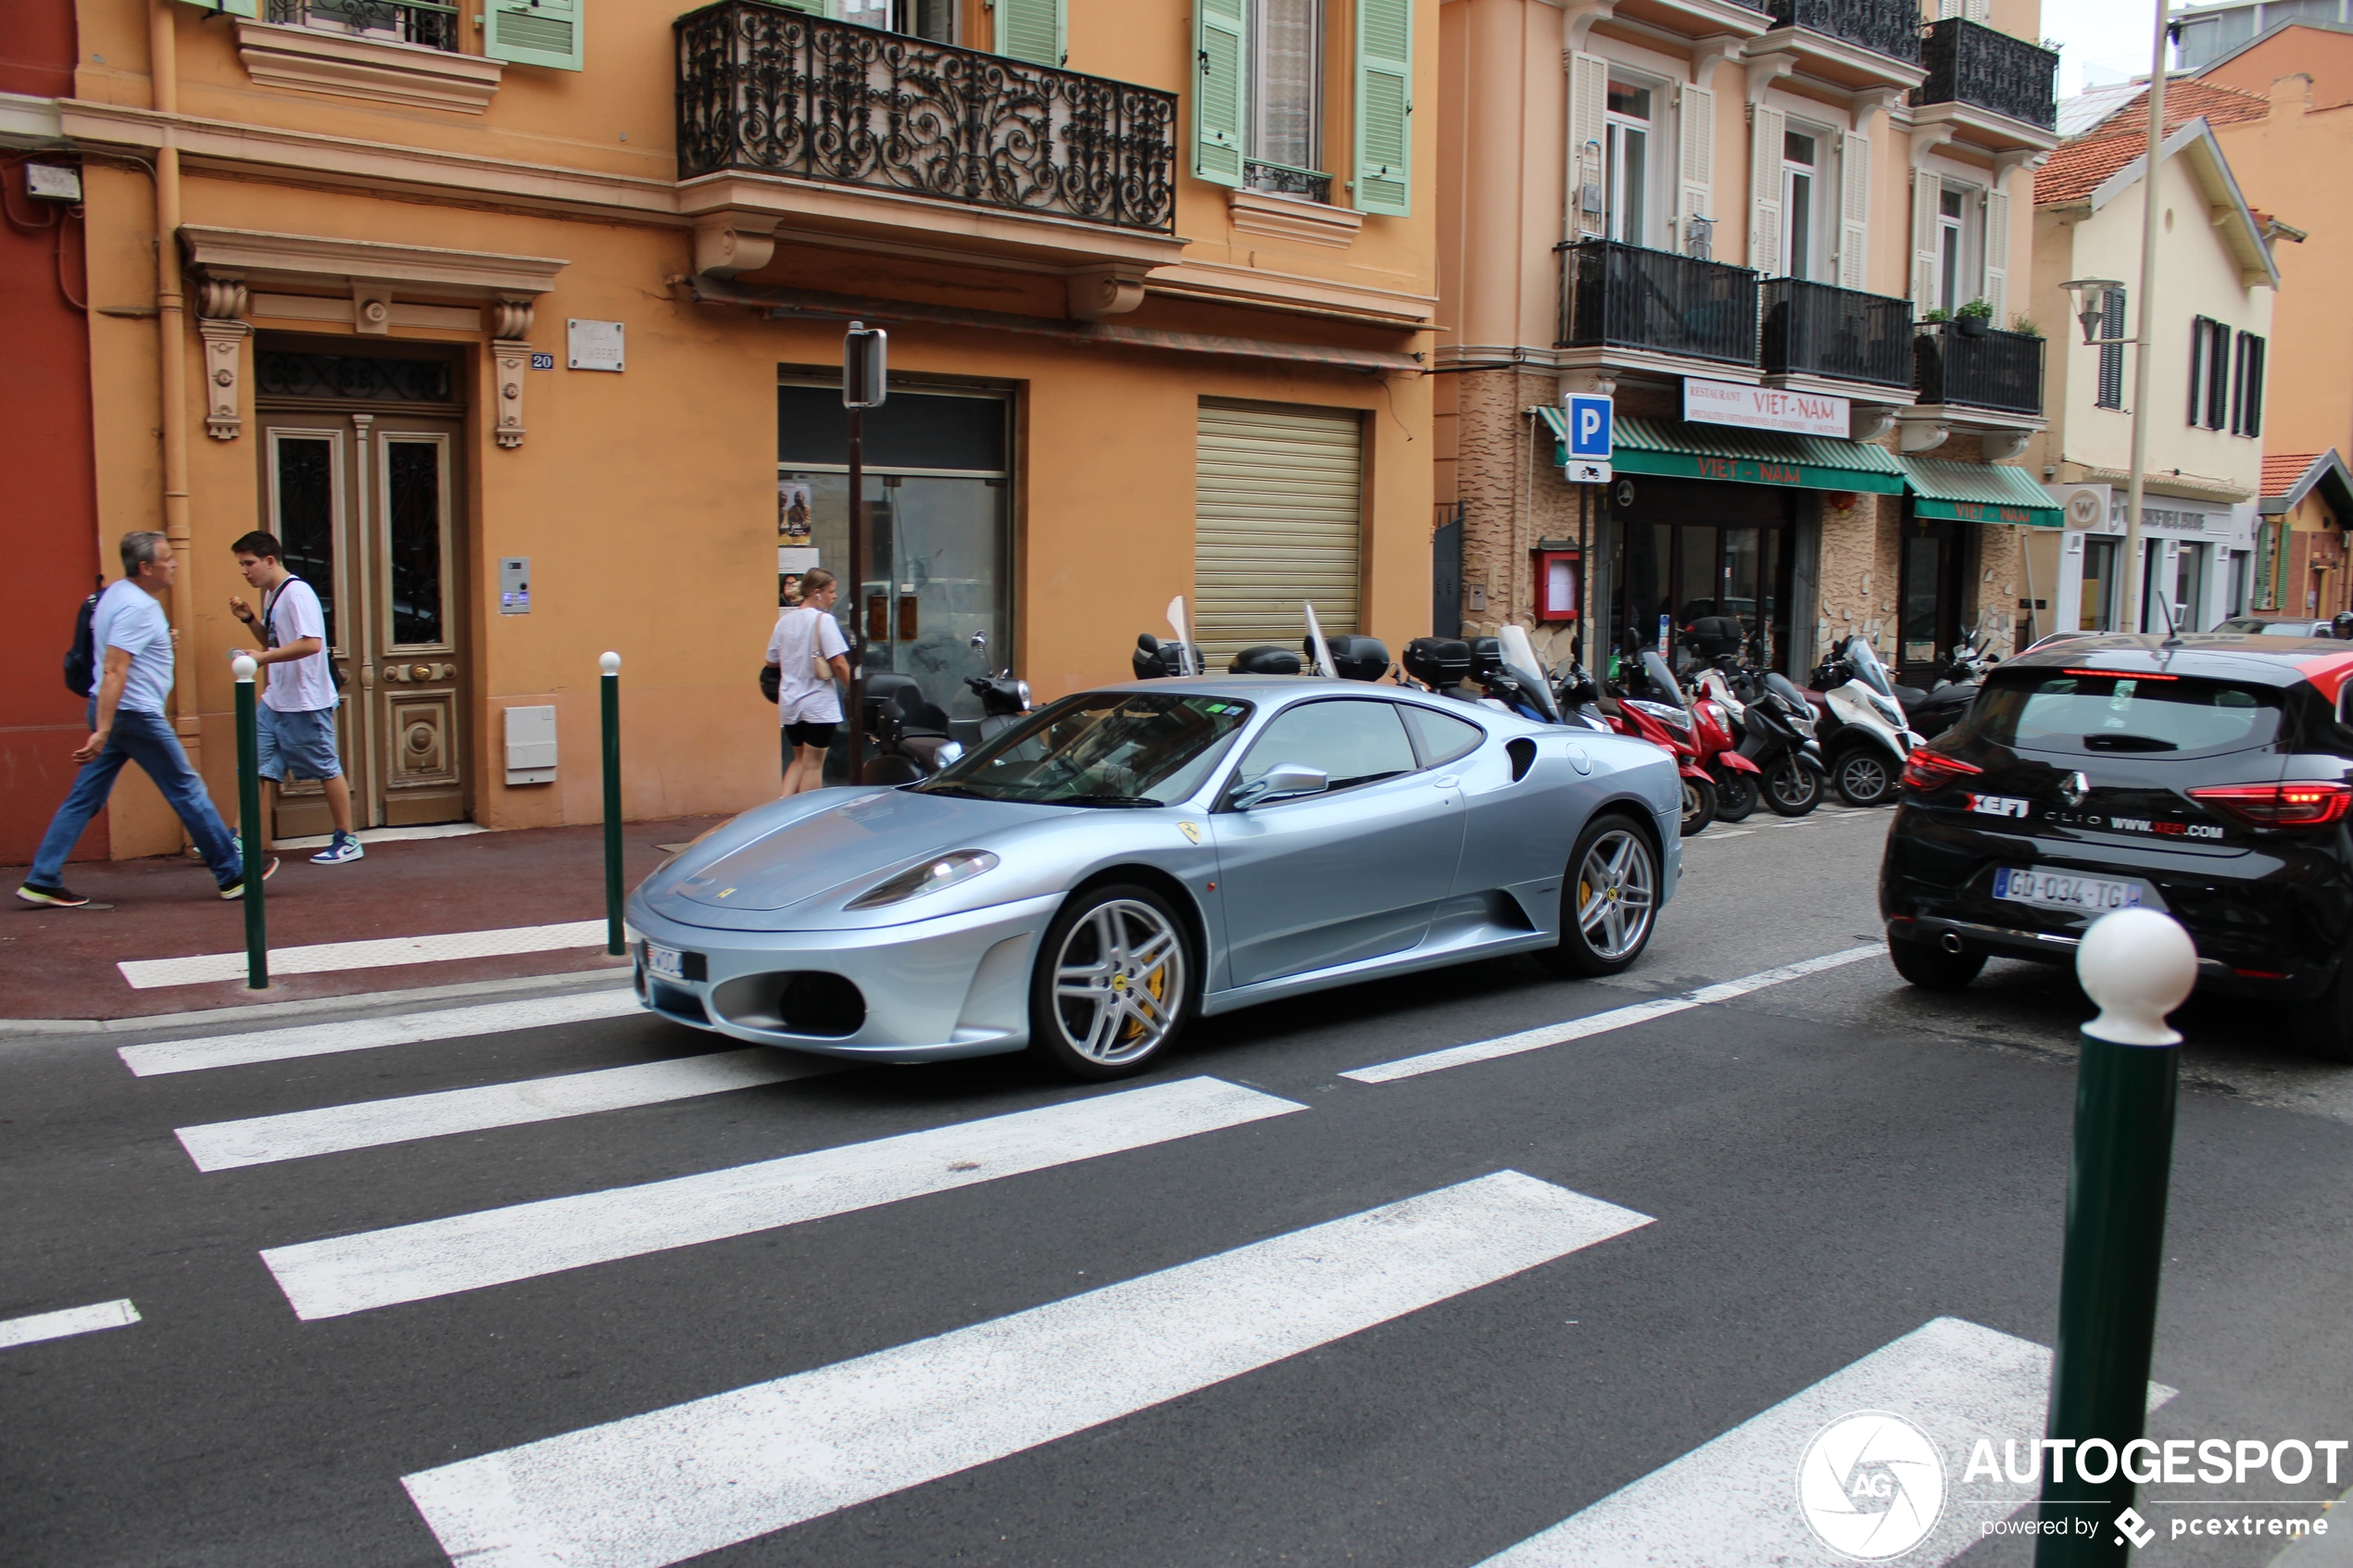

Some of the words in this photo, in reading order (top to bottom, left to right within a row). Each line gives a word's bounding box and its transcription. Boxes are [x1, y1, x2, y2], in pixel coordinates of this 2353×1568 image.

[533, 355, 552, 368] 20
[1689, 385, 1742, 402] RESTAURANT
[1580, 408, 1601, 445] P
[1697, 457, 1739, 478] VIET
[1758, 462, 1800, 484] NAM
[1955, 502, 1985, 519] VIET
[1999, 506, 2030, 523] NAM
[2074, 501, 2095, 519] W
[1964, 793, 2029, 818] XEFI
[2044, 811, 2102, 824] CLIO
[2110, 817, 2223, 838] WWW.XEFI.COM
